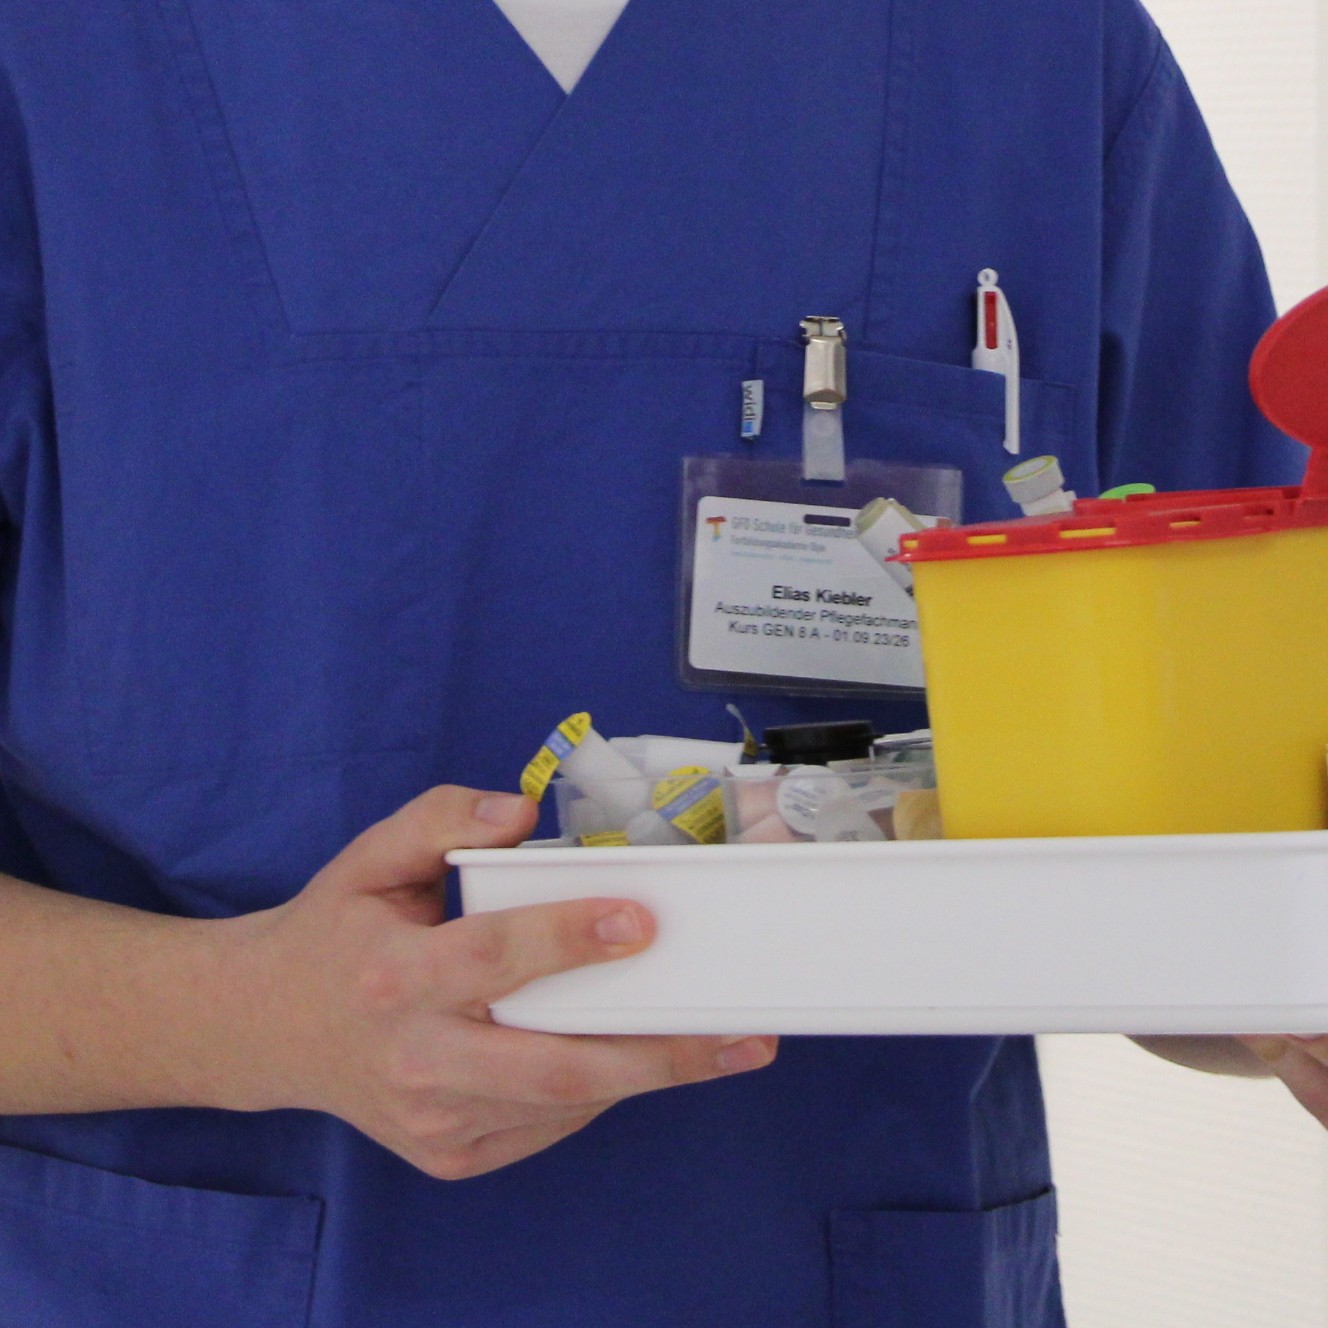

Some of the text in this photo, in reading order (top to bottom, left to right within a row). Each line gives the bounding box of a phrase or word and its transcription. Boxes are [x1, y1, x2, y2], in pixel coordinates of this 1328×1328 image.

[772, 584, 810, 602] Elias
[715, 601, 918, 630] Auszubildender Pflegefachman
[728, 620, 759, 635] Kurs
[763, 622, 794, 637] GEN
[809, 626, 821, 639] A
